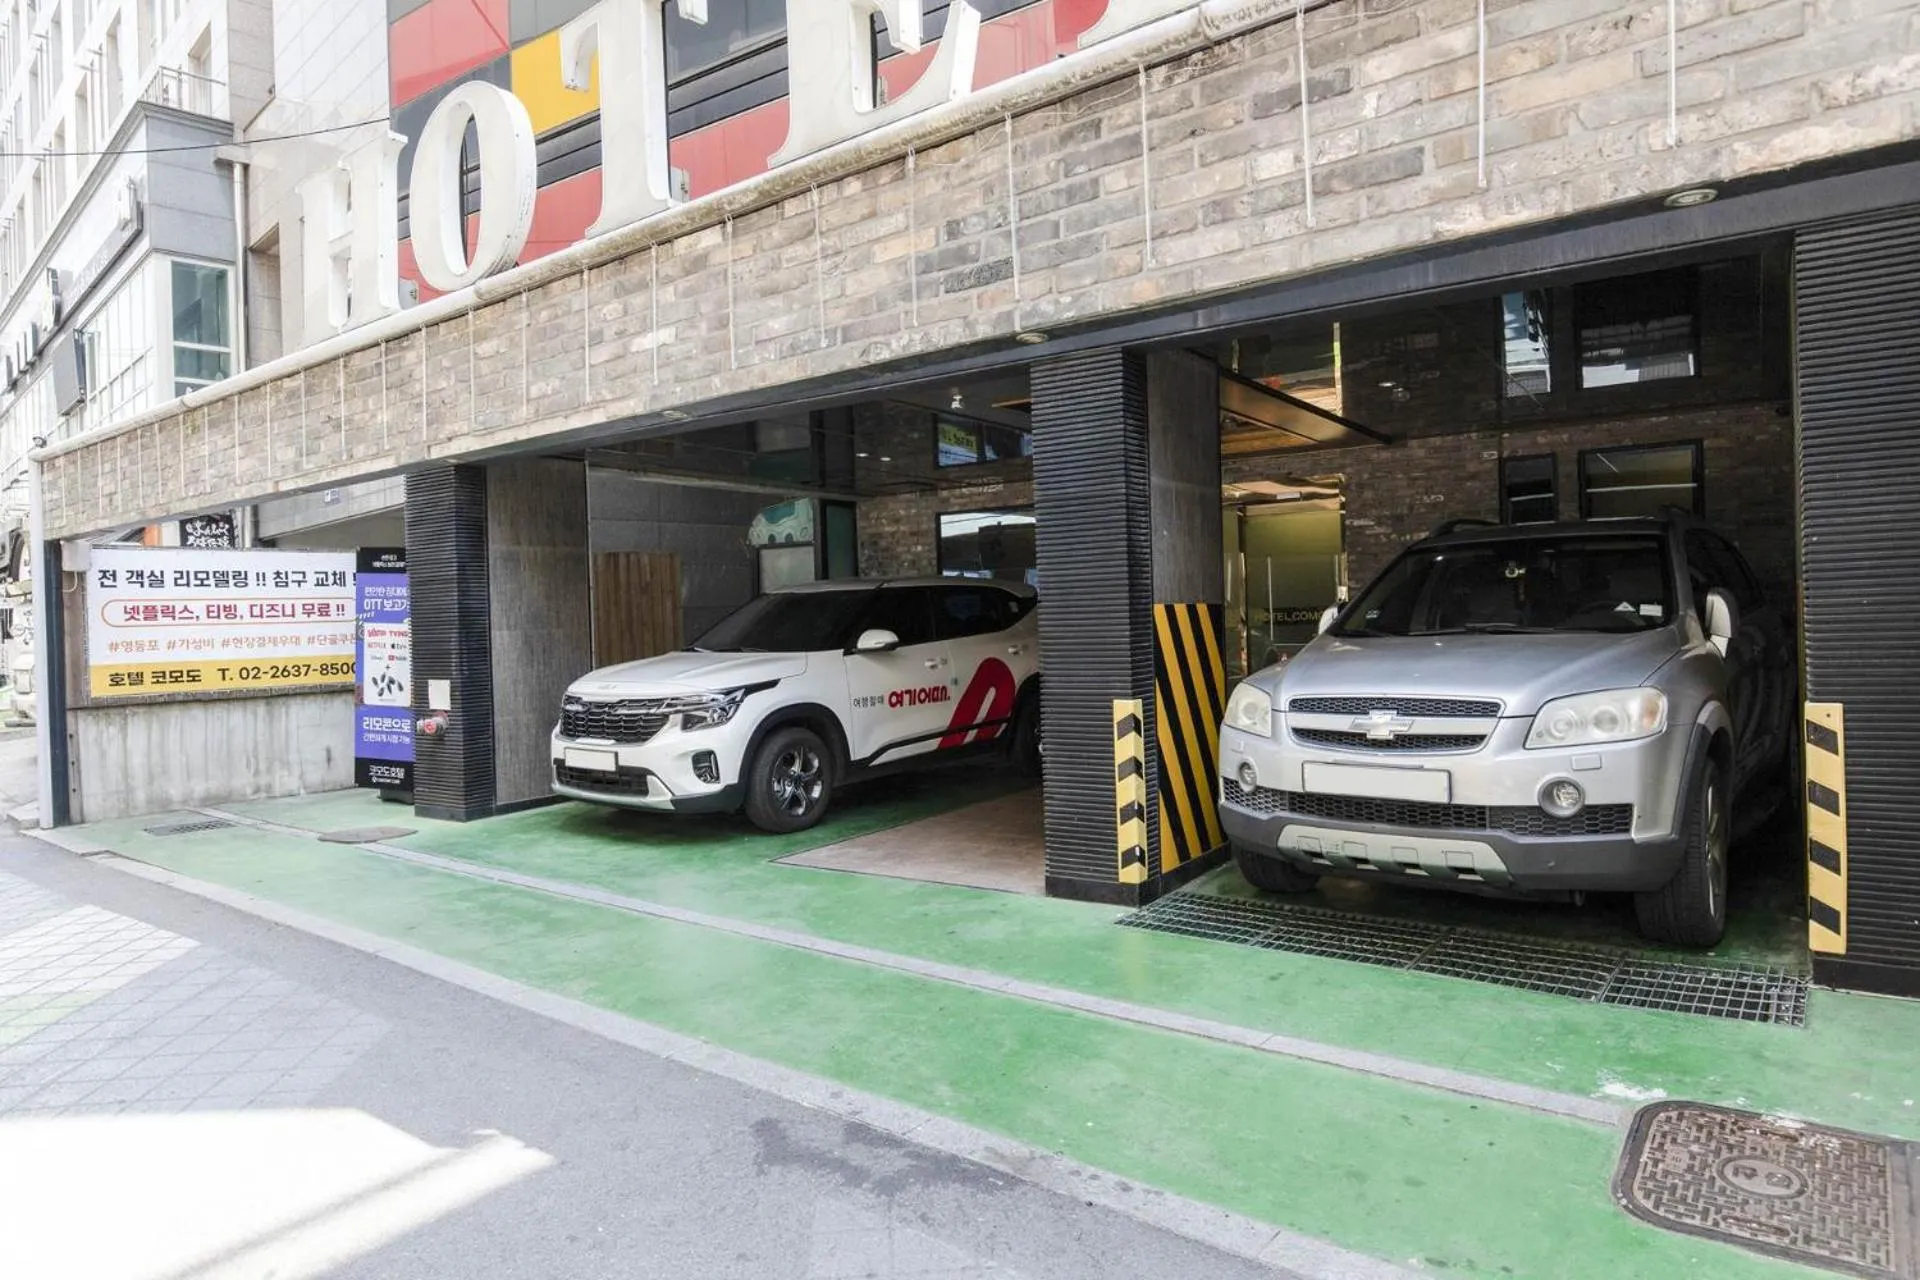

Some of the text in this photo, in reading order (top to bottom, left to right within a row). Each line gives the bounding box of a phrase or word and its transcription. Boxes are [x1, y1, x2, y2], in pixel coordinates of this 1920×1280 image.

[98, 569, 117, 588] 전
[126, 569, 164, 588] 객실
[173, 570, 248, 588] 리모델링
[273, 570, 307, 588] 침구
[314, 570, 346, 588] 교체
[123, 604, 199, 622] 넷플릭스,
[206, 604, 244, 620] 티빙,
[249, 603, 295, 619] 디즈니
[302, 603, 331, 619] 무료
[364, 598, 382, 610] OTT
[108, 639, 160, 653] #영등포
[108, 671, 144, 687] 호텔
[151, 669, 202, 684] 코모도
[217, 667, 233, 681] T.
